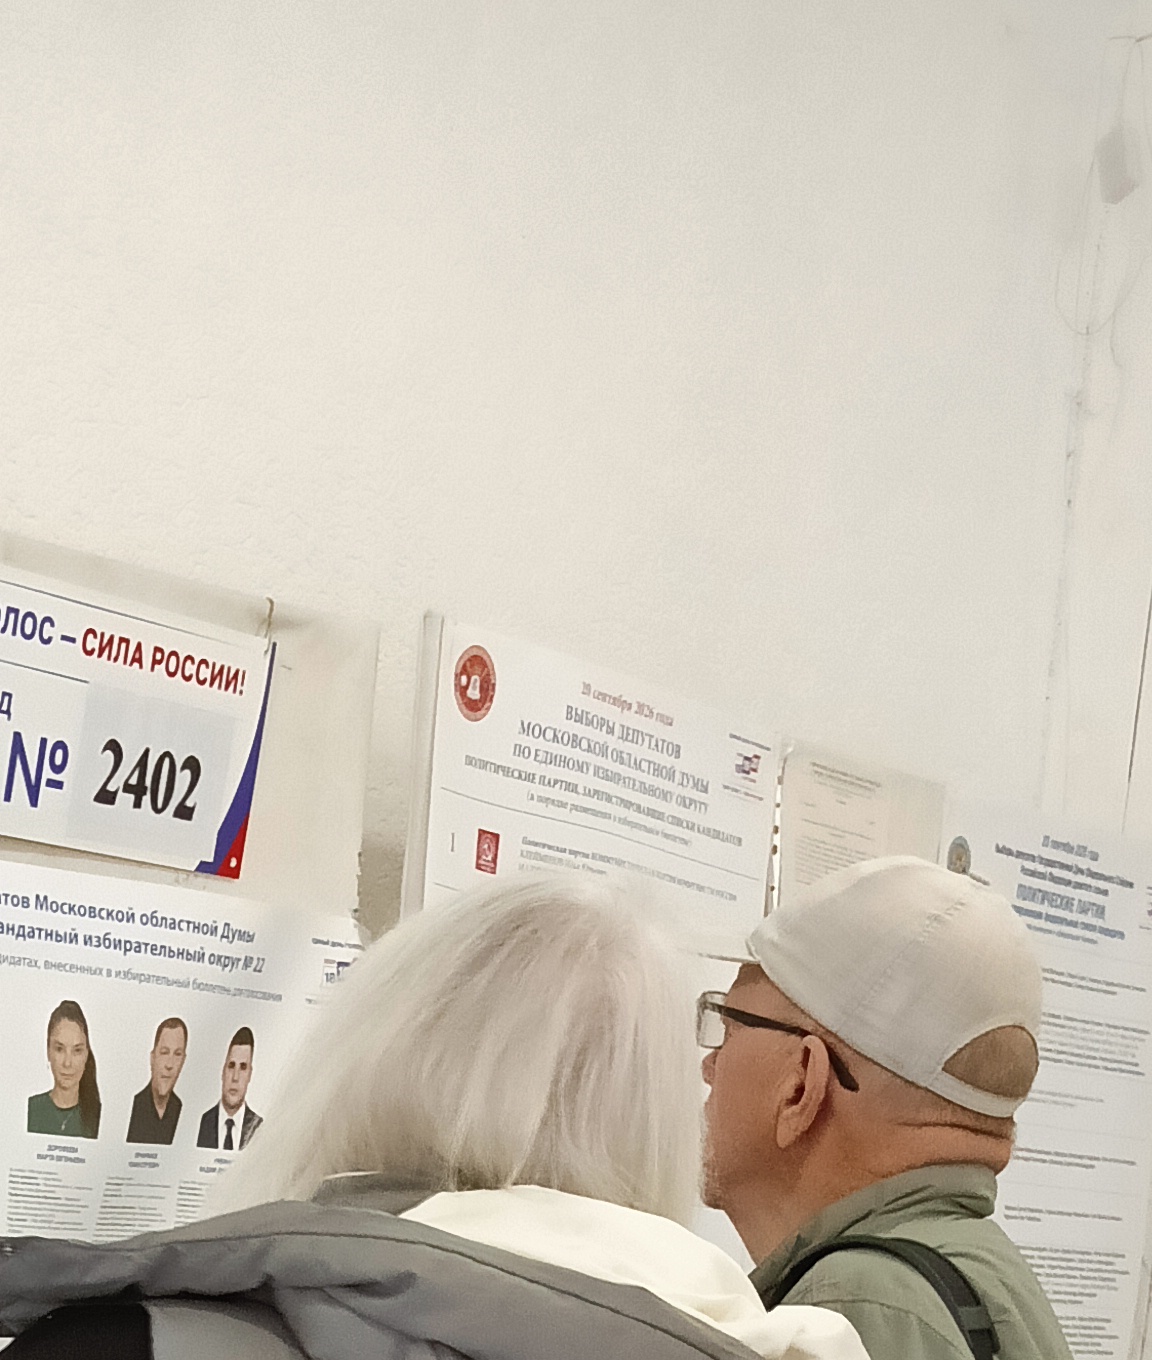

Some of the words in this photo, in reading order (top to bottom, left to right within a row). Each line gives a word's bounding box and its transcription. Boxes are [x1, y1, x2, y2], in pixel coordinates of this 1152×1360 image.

[81, 628, 143, 669] СИЛА
[150, 649, 247, 696] РОССИИ!
[518, 720, 609, 758] МОСКОВСКОЙ
[610, 748, 676, 783] ОБЛАСТНОЙ
[678, 771, 710, 795] ДУМЫ
[565, 705, 615, 737] ВЫБОРЫ
[617, 723, 681, 759] ДЕПУТАТОВ
[3, 731, 70, 808] №
[93, 738, 202, 822] 2402
[464, 755, 537, 784] ПОЛИТИЧЕСКИЕ
[512, 743, 531, 760] ПО
[534, 748, 592, 775] ЕДИНОМУ
[593, 765, 677, 804] ИЗБИРАТЕЛЬНОМУ
[34, 894, 135, 924] Московской
[139, 909, 218, 937] областной
[220, 922, 256, 945] Думы
[44, 960, 103, 977] внесенных
[106, 968, 112, 978] в
[115, 969, 190, 989] избирательный
[83, 932, 205, 964] избирательный
[208, 953, 242, 973] округ
